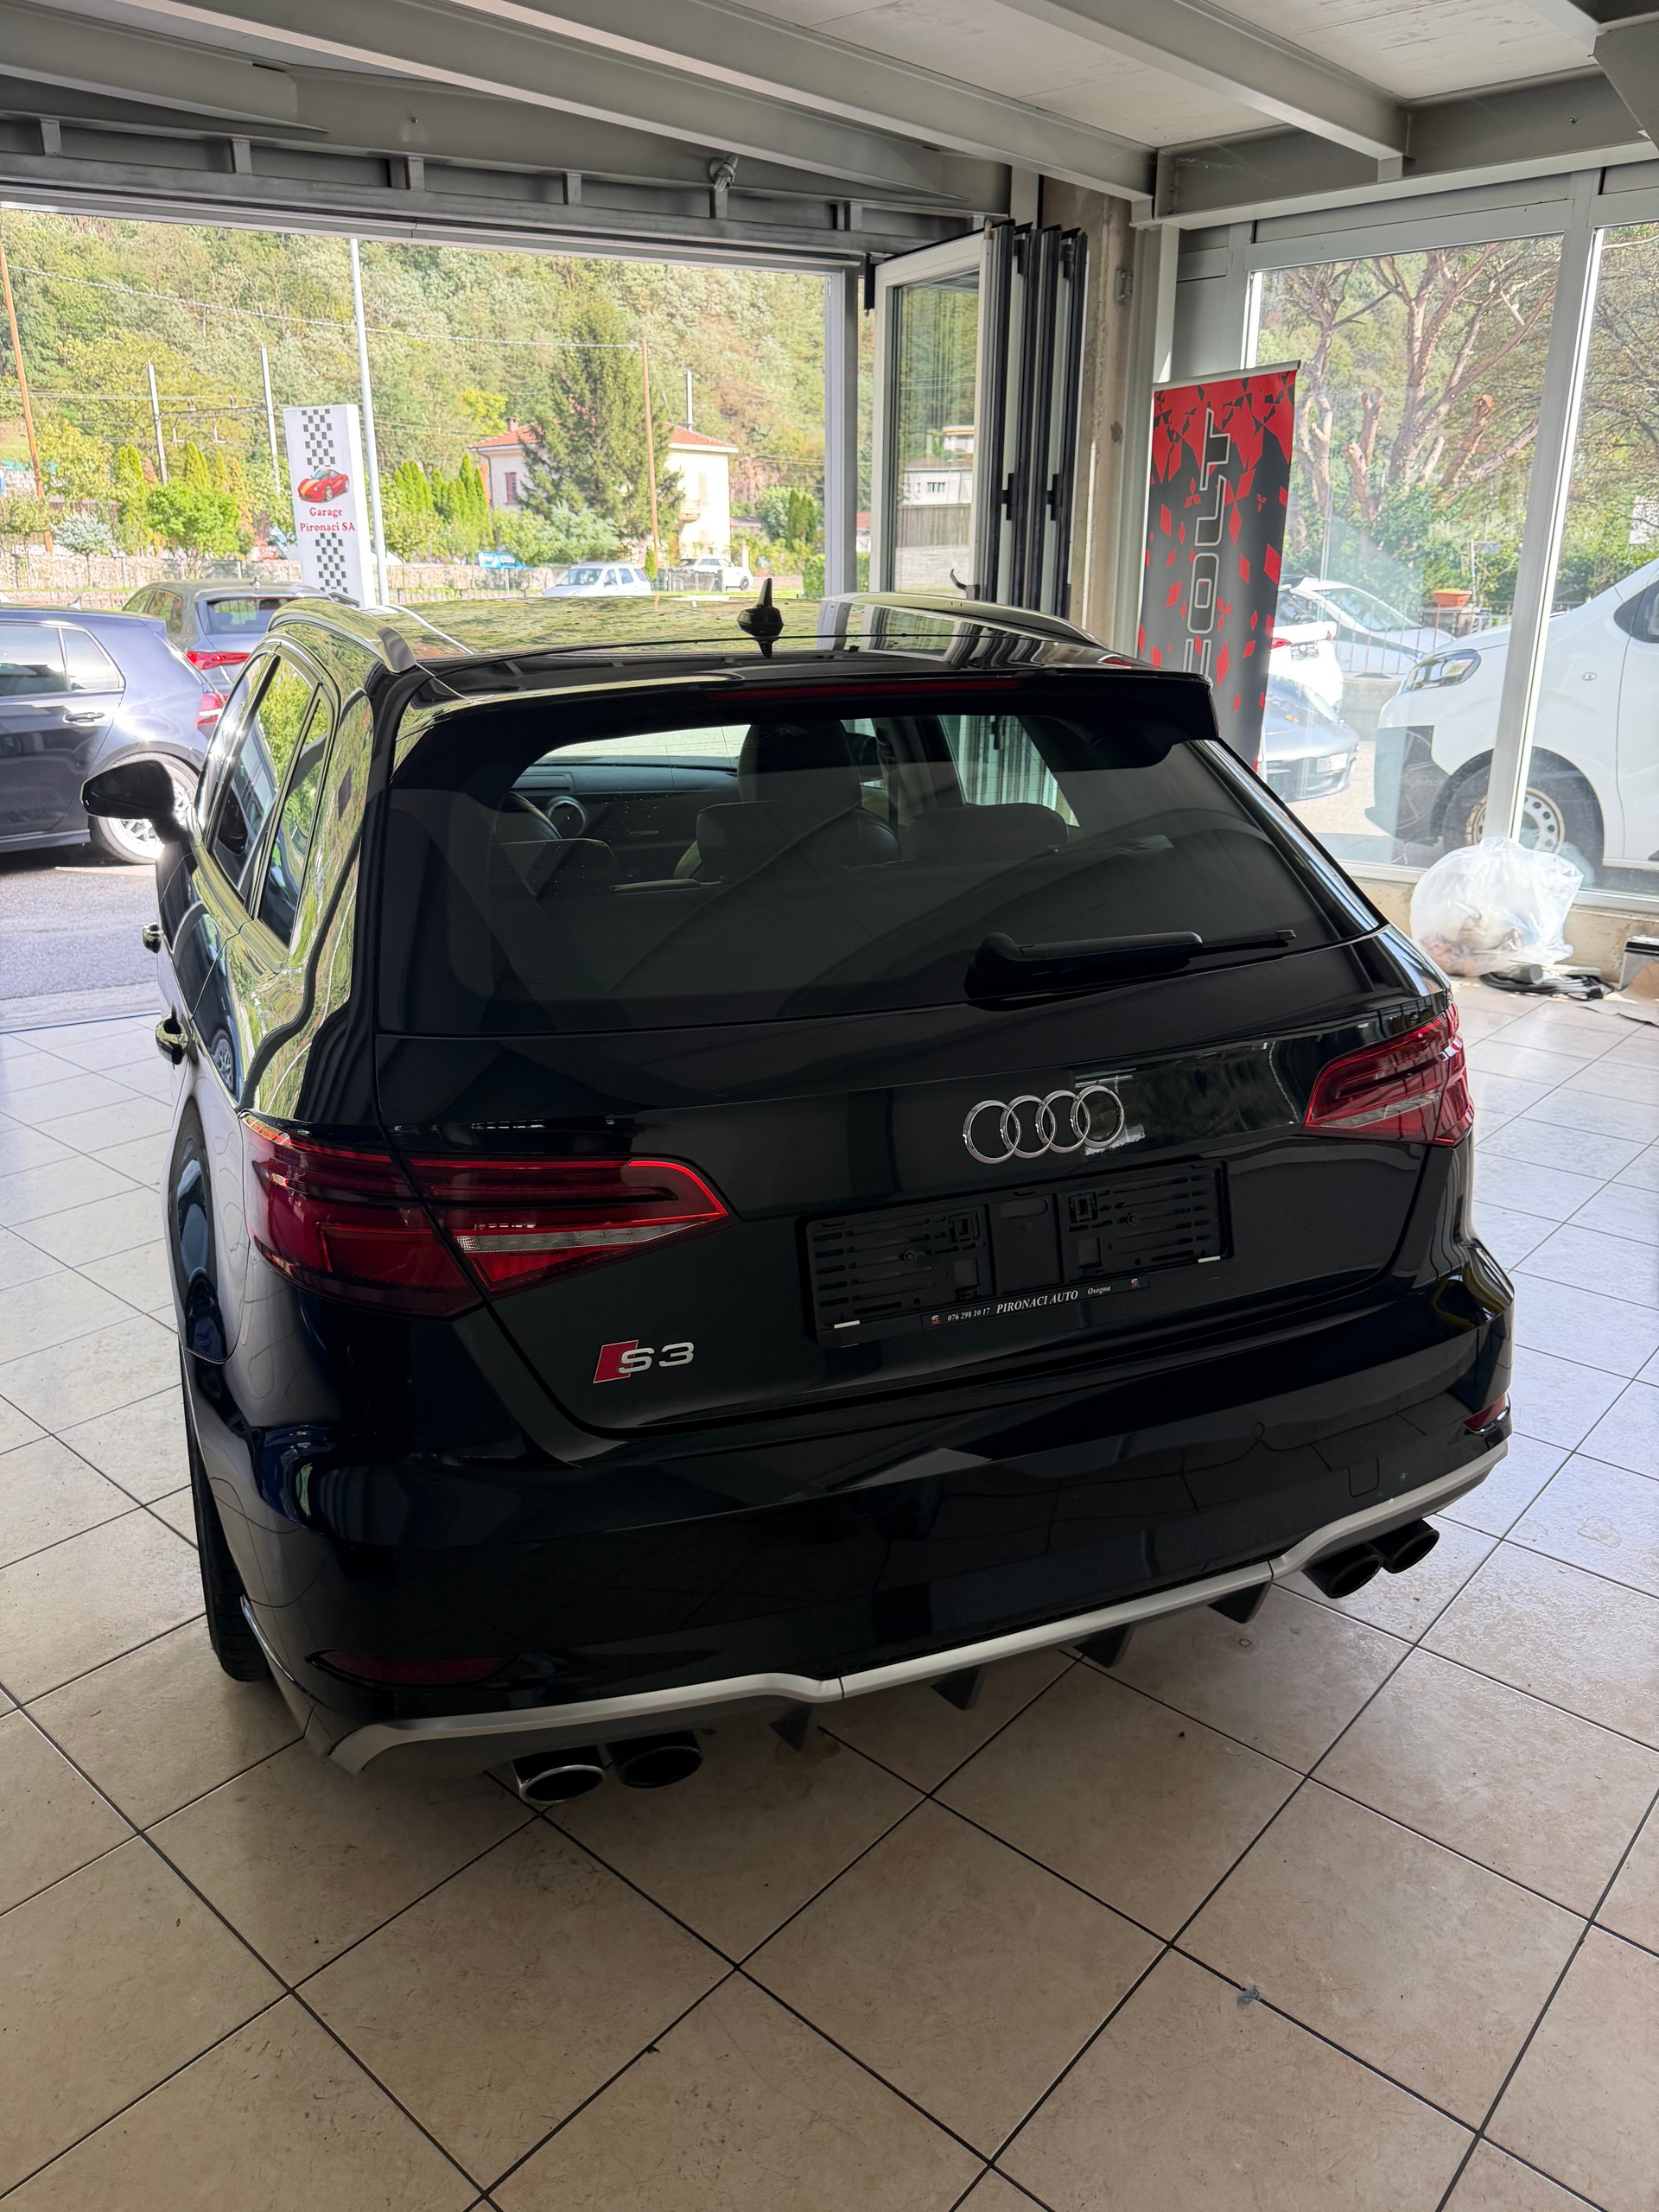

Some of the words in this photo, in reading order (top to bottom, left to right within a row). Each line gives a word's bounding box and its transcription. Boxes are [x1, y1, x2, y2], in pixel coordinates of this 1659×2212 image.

[309, 506, 343, 518] Garage
[299, 521, 340, 532] Pironaci
[341, 521, 355, 531] SA
[947, 1313, 959, 1322] 076
[960, 1311, 972, 1319] 298
[982, 1306, 991, 1315] 17
[995, 1294, 1048, 1314] PIRONACI
[1049, 1289, 1079, 1305] AUTO
[1087, 1286, 1111, 1295] Osogna
[617, 1341, 695, 1375] S3
